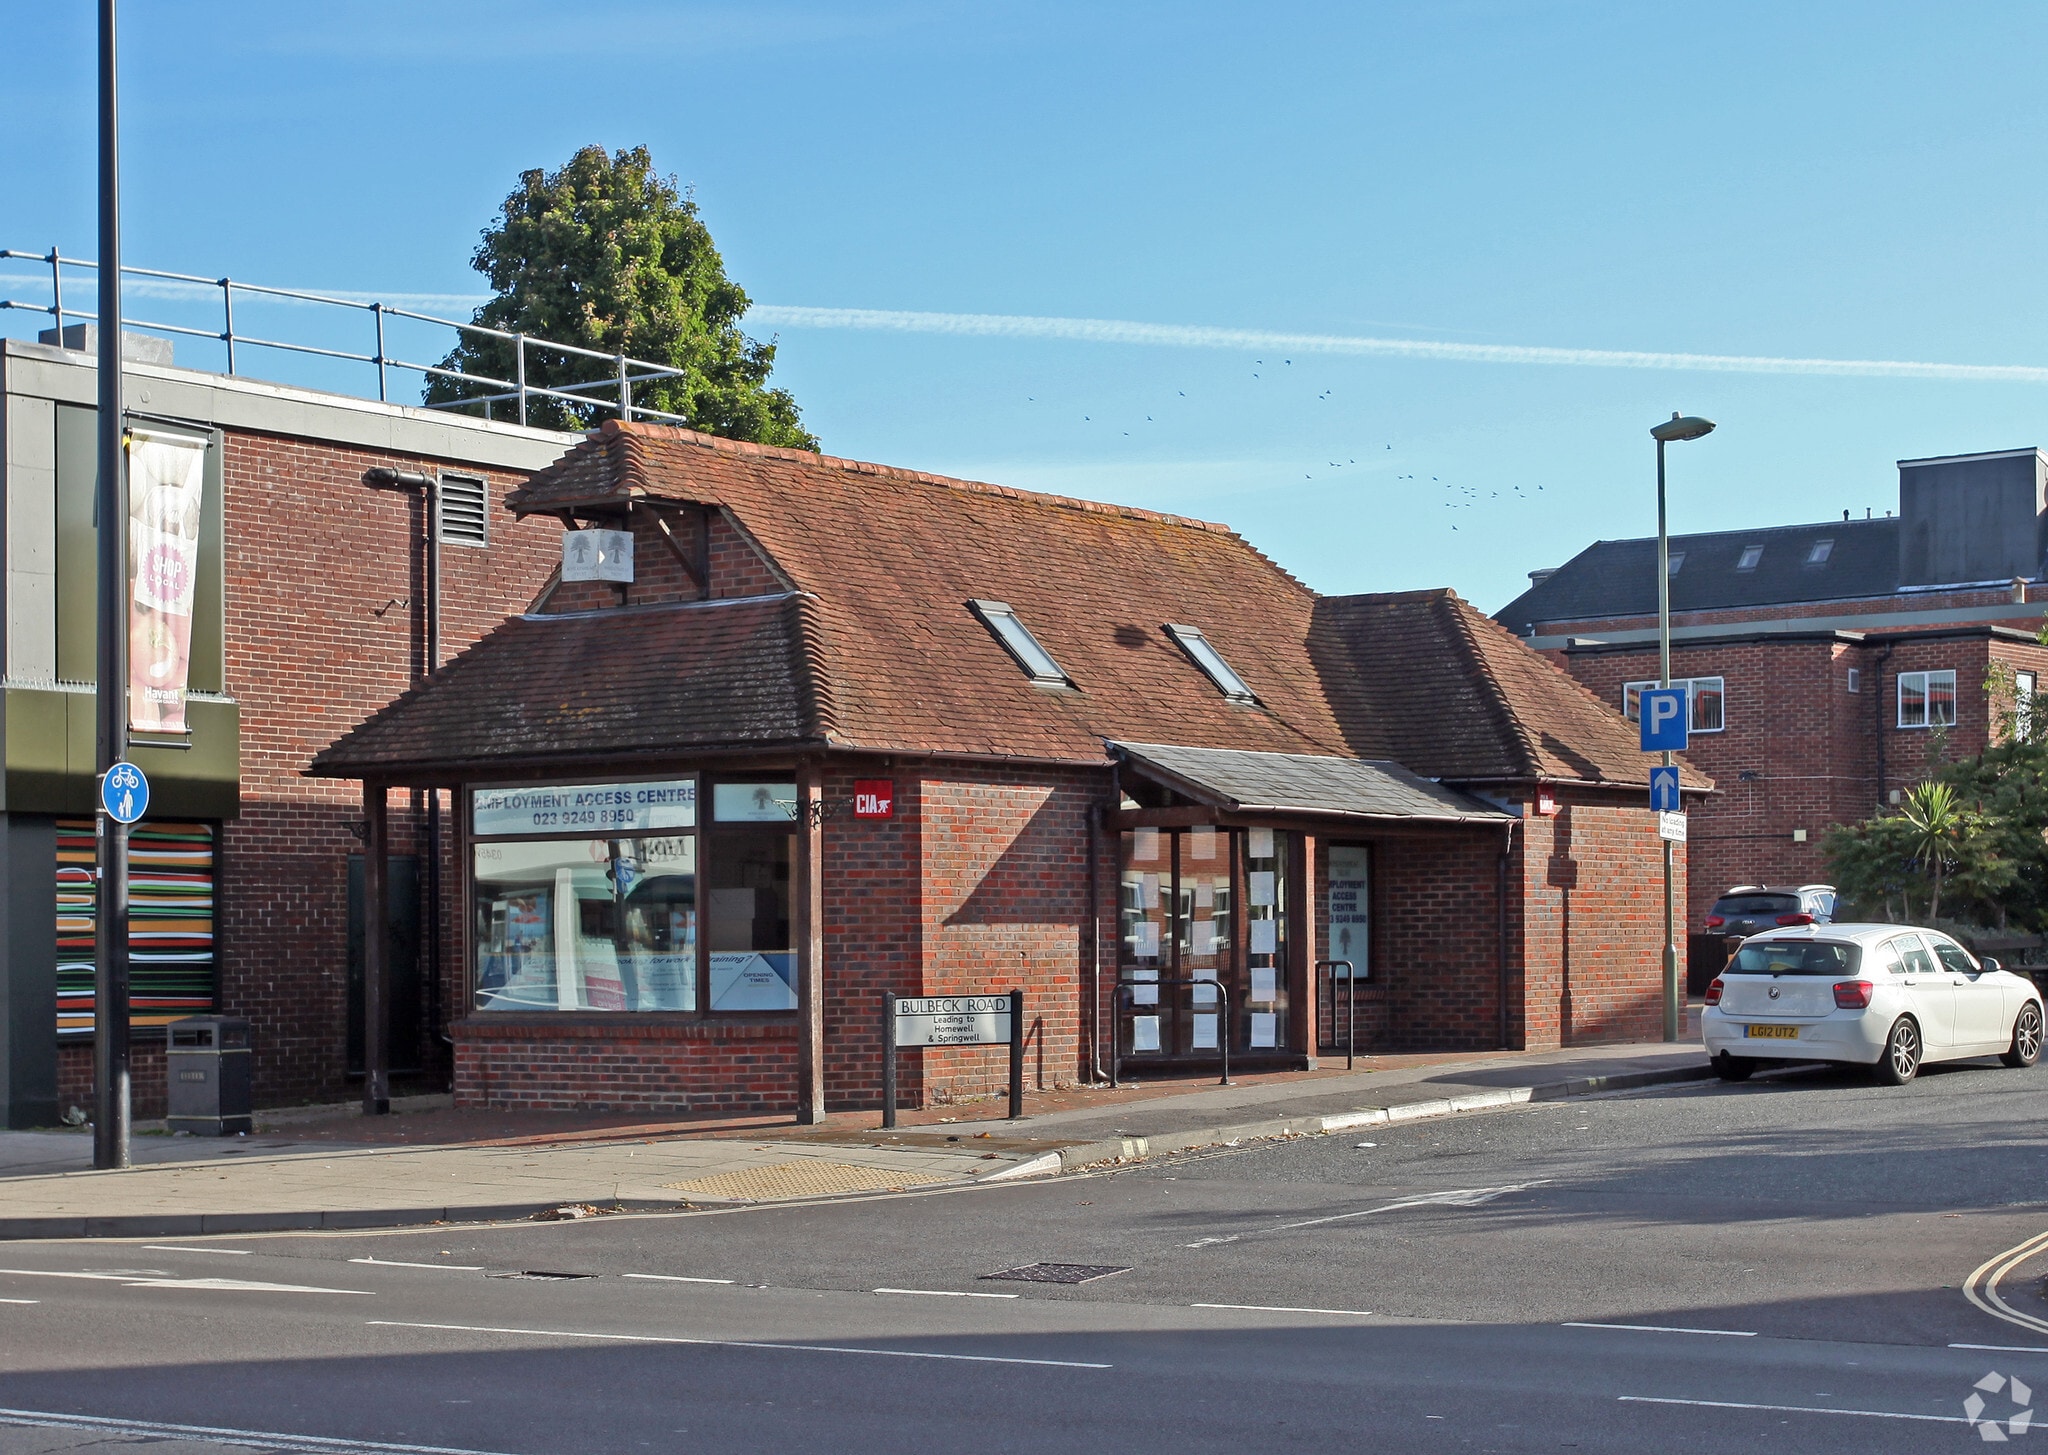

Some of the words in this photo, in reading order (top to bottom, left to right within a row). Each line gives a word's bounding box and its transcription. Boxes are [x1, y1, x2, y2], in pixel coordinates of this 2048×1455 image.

[152, 553, 182, 579] SHOP
[149, 574, 180, 590] LOCAL
[144, 686, 179, 700] Havant
[1650, 695, 1678, 735] P
[575, 790, 632, 807] ACCESS
[636, 787, 695, 804] CENTRE
[856, 794, 878, 814] CIA
[533, 811, 557, 826] 023
[562, 810, 596, 825] 9249
[600, 808, 634, 823] 8950
[1332, 891, 1357, 901] ACCESS
[1332, 903, 1358, 912] CENTRE
[649, 956, 665, 966] for
[665, 956, 691, 965] work
[709, 954, 753, 965] raining?
[901, 999, 961, 1014] BULBECK
[967, 998, 1006, 1012] ROAD
[933, 1015, 963, 1025] Leading
[966, 1015, 975, 1023] to
[934, 1025, 974, 1033] Homewell
[1751, 1026, 1773, 1037] LG12
[1775, 1027, 1795, 1037] UTZ
[928, 1034, 935, 1042] &
[937, 1033, 980, 1044] Springwell
